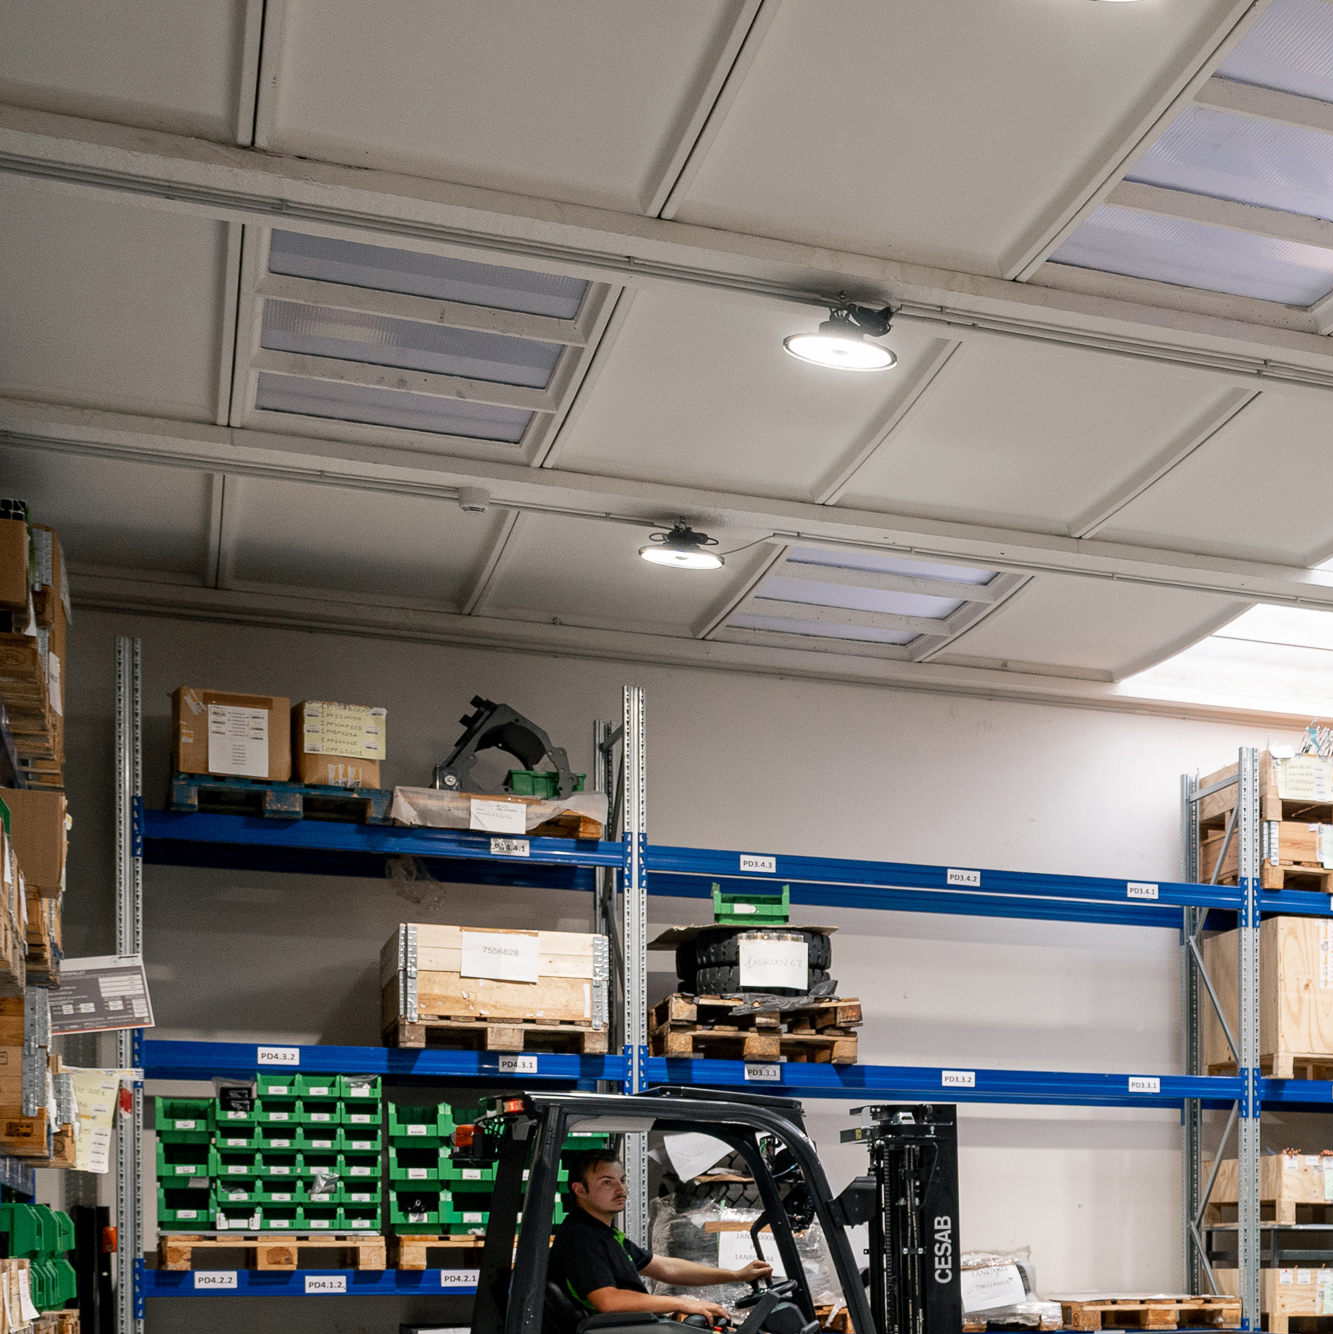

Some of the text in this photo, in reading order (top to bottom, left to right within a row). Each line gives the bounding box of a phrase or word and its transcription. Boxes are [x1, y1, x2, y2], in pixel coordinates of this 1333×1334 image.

[743, 860, 773, 869] PD3.4.3
[949, 874, 977, 883] PD3.4.2
[1129, 887, 1156, 895] PD3.4.1
[482, 946, 519, 957] 7556828
[261, 1052, 295, 1060] PD4.3.2
[501, 1061, 534, 1069] PD4.3.1
[934, 1215, 952, 1283] CESAB
